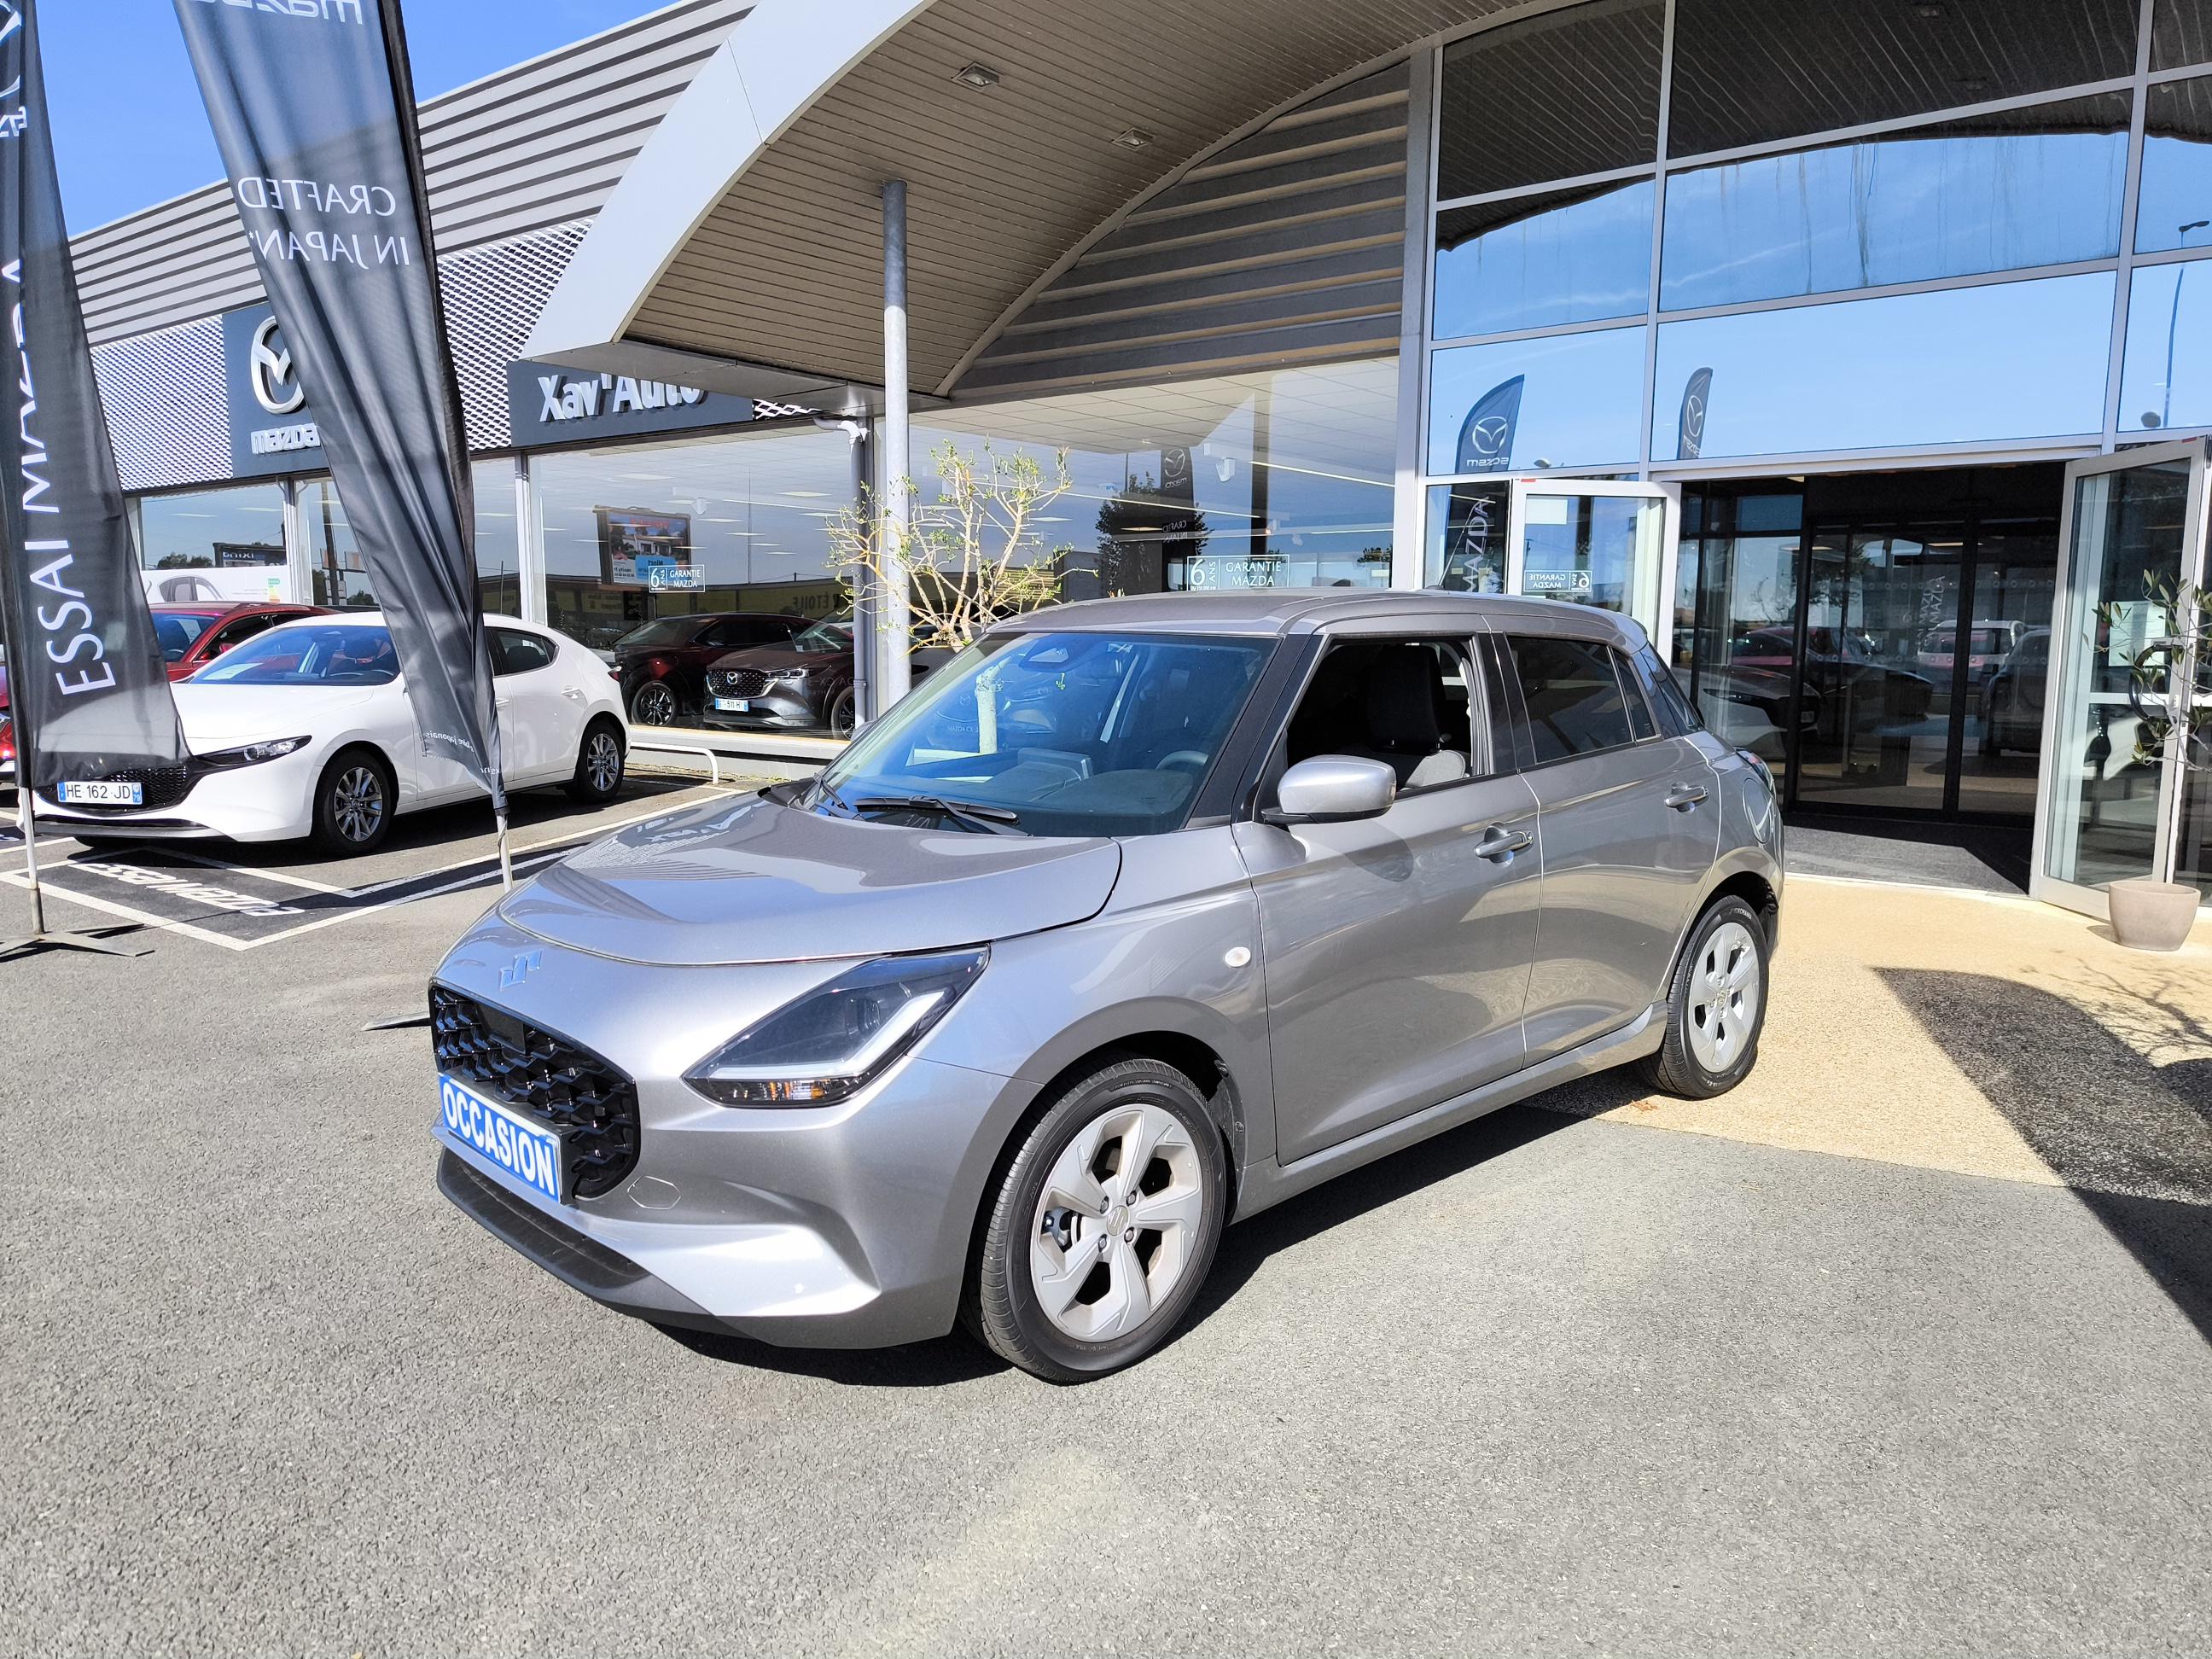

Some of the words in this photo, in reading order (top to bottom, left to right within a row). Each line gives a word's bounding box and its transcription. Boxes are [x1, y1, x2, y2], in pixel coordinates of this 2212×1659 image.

[669, 569, 701, 578] GARANTIE
[1190, 558, 1206, 586] 6
[1225, 561, 1282, 573] GARANTIE
[650, 568, 660, 588] 6
[672, 579, 698, 588] MAZDA
[1231, 575, 1275, 586] MAZDA
[25, 539, 117, 696] ESSAI
[67, 784, 82, 799] HE
[87, 784, 108, 799] 162
[114, 784, 131, 800] JD
[443, 1081, 555, 1196] OCCASION
